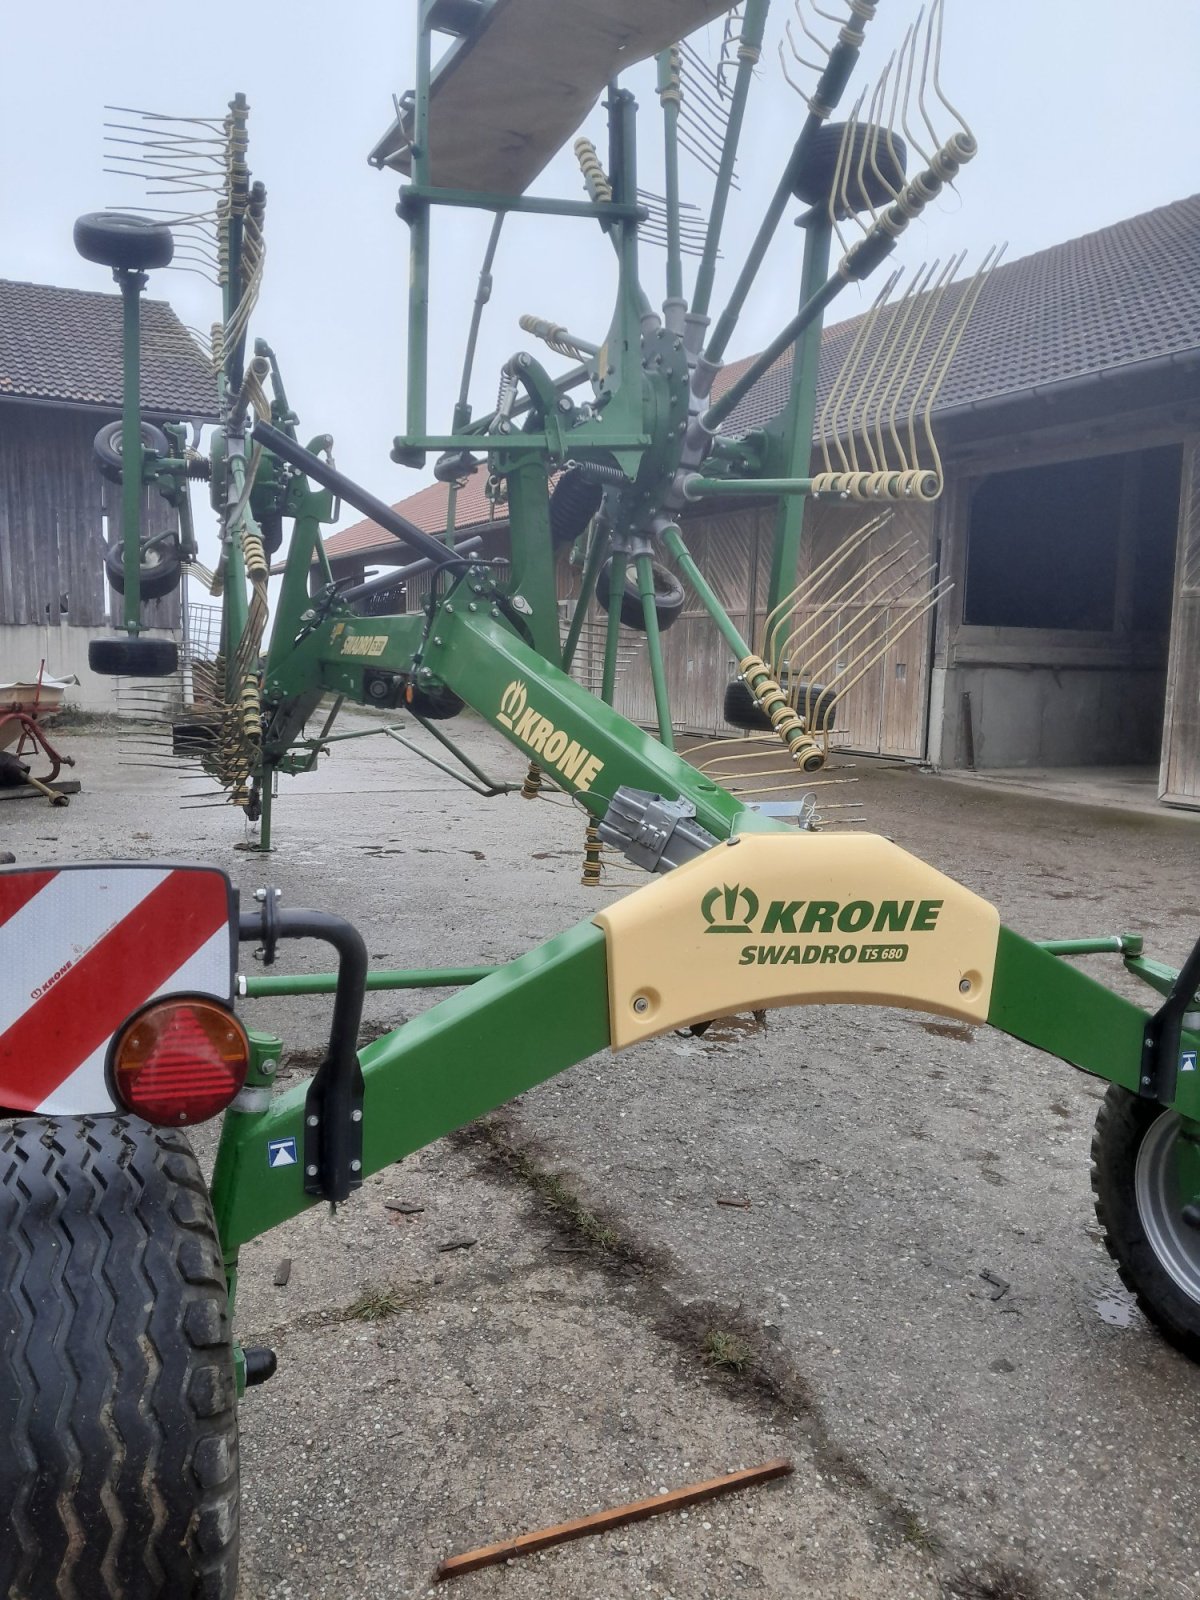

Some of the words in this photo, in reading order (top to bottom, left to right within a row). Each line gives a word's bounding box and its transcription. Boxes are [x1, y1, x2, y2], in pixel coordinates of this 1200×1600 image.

[513, 707, 605, 791] KRONE
[760, 899, 944, 933] KRONE
[738, 944, 858, 965] SWADRO
[864, 948, 878, 960] TS
[881, 947, 903, 960] 680
[42, 960, 73, 992] KRONE
